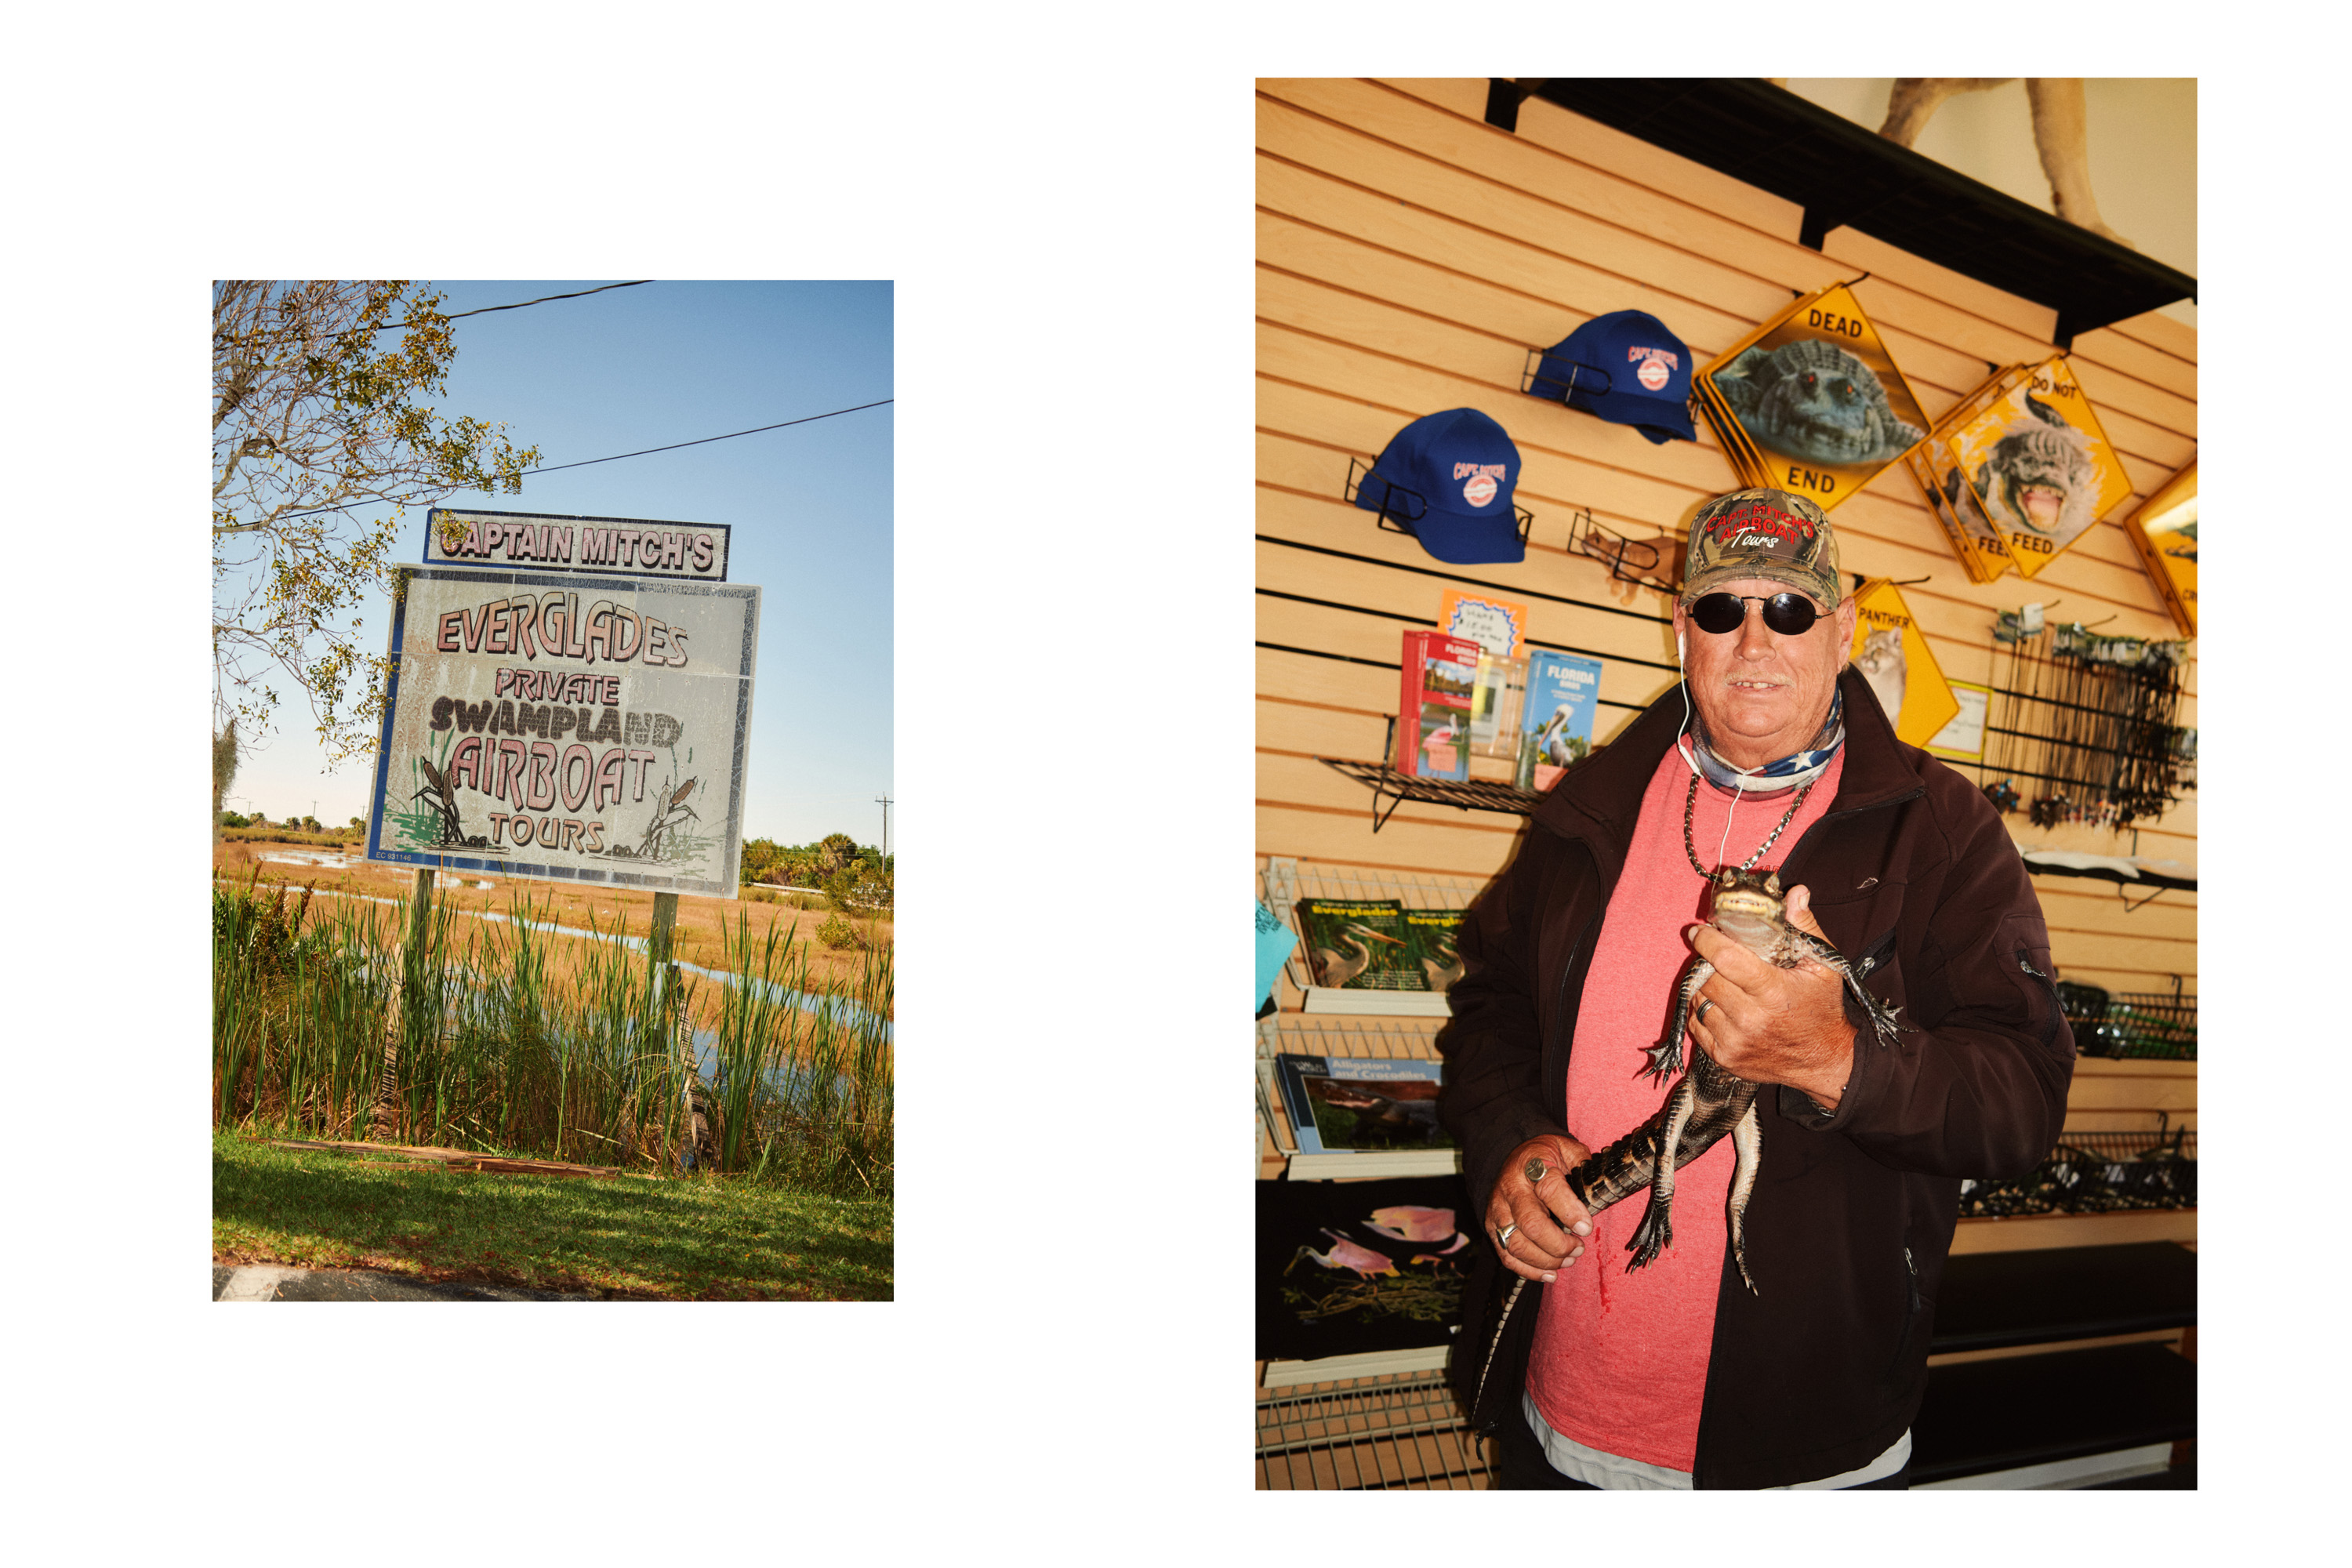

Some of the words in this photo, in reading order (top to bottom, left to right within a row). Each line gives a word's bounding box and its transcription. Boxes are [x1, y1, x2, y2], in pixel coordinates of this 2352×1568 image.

[1809, 309, 1863, 338] DEAD
[2031, 376, 2049, 391] DO
[2053, 383, 2077, 400] NOT
[1787, 466, 1835, 494] END
[1706, 508, 1748, 532] CAPT.
[1752, 505, 1814, 539] MITCH'S
[1719, 517, 1798, 545] AIRBOAT
[440, 518, 574, 564] CAPTAIN
[581, 527, 713, 572] MITCH'S
[1730, 526, 1780, 549] Tours
[1977, 535, 2010, 558] FEE
[2012, 532, 2053, 554] FEED
[437, 591, 688, 668] EVERGLADES
[1858, 607, 1910, 629] PANTHER
[1444, 643, 1478, 658] FLORIDA
[495, 667, 620, 706] PRIVATE
[1547, 664, 1595, 686] FLORIDA
[429, 695, 682, 748] SWAMPLAND
[451, 736, 656, 813] AIRBOAT
[488, 811, 605, 855] TOURS
[387, 853, 412, 862] 931146
[1312, 905, 1399, 917] Everglades
[1333, 1059, 1392, 1071] Alligators
[1334, 1070, 1358, 1079] and
[1360, 1070, 1427, 1080] Crocodiles
